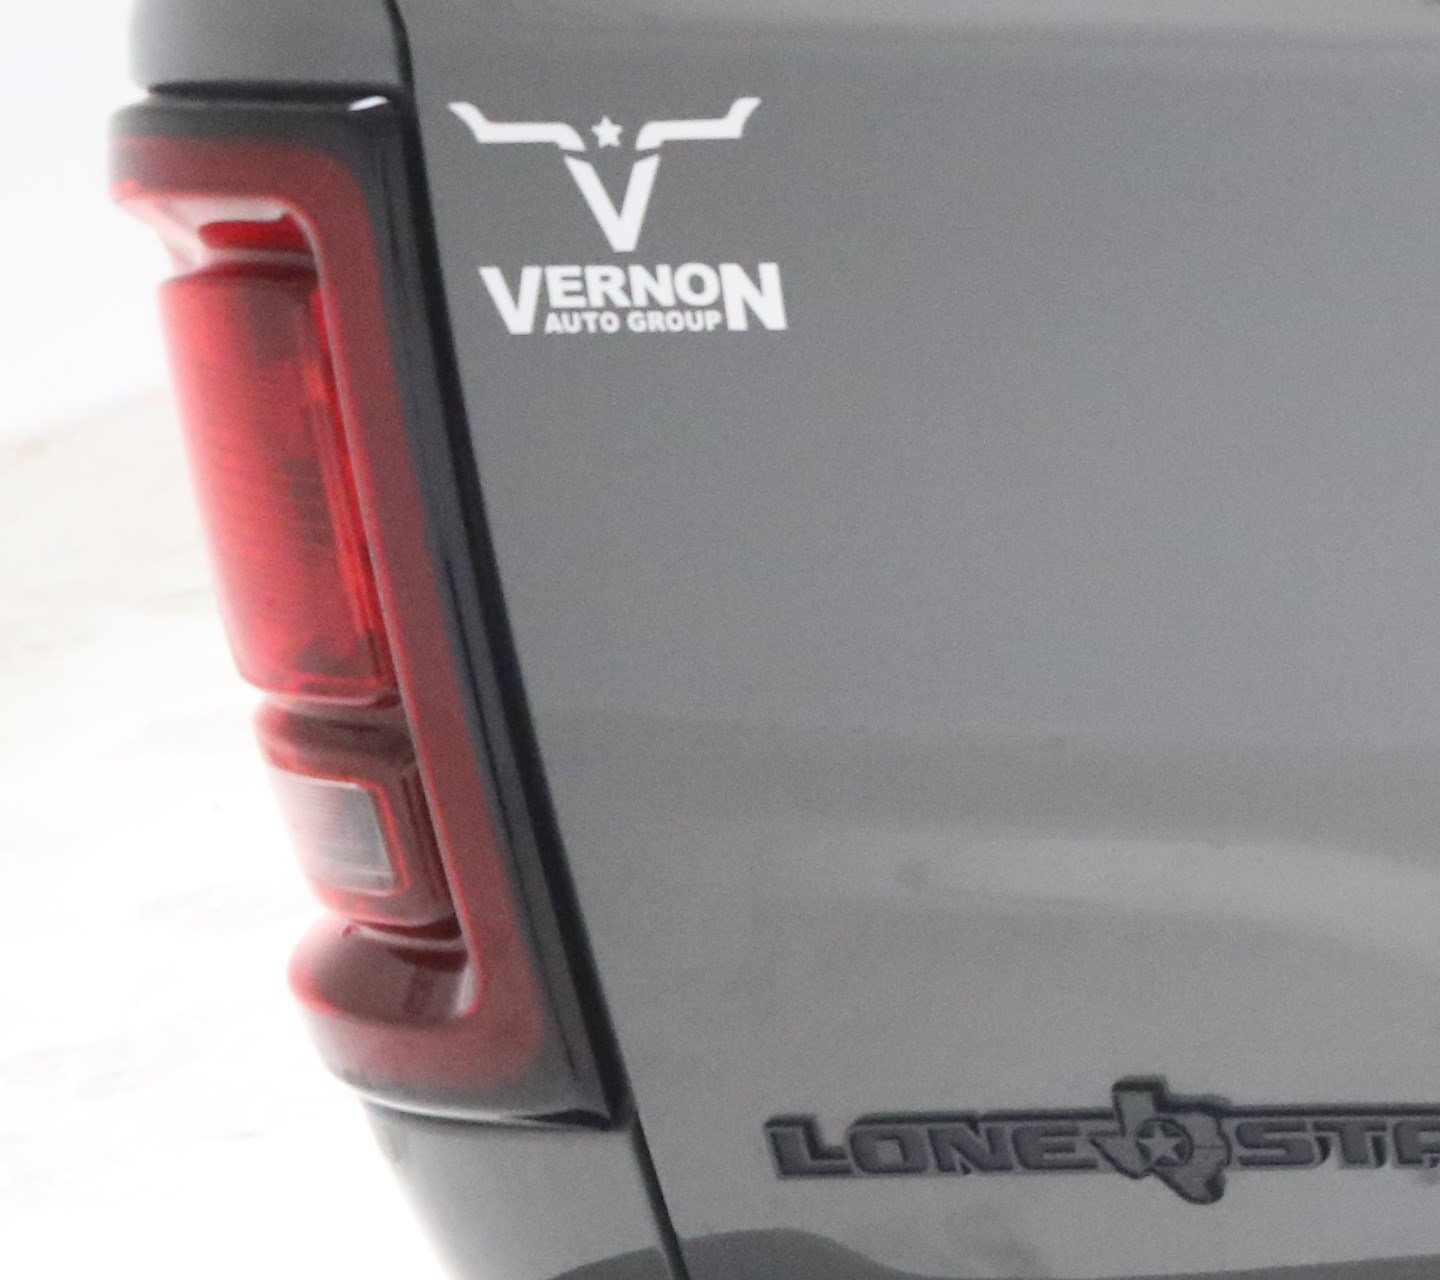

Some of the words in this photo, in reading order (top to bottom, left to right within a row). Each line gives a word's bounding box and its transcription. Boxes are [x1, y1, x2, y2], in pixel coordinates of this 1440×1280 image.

[478, 262, 788, 336] VERNON
[544, 311, 619, 334] AUTO
[627, 309, 723, 333] GROUP
[764, 1112, 1113, 1180] LONE
